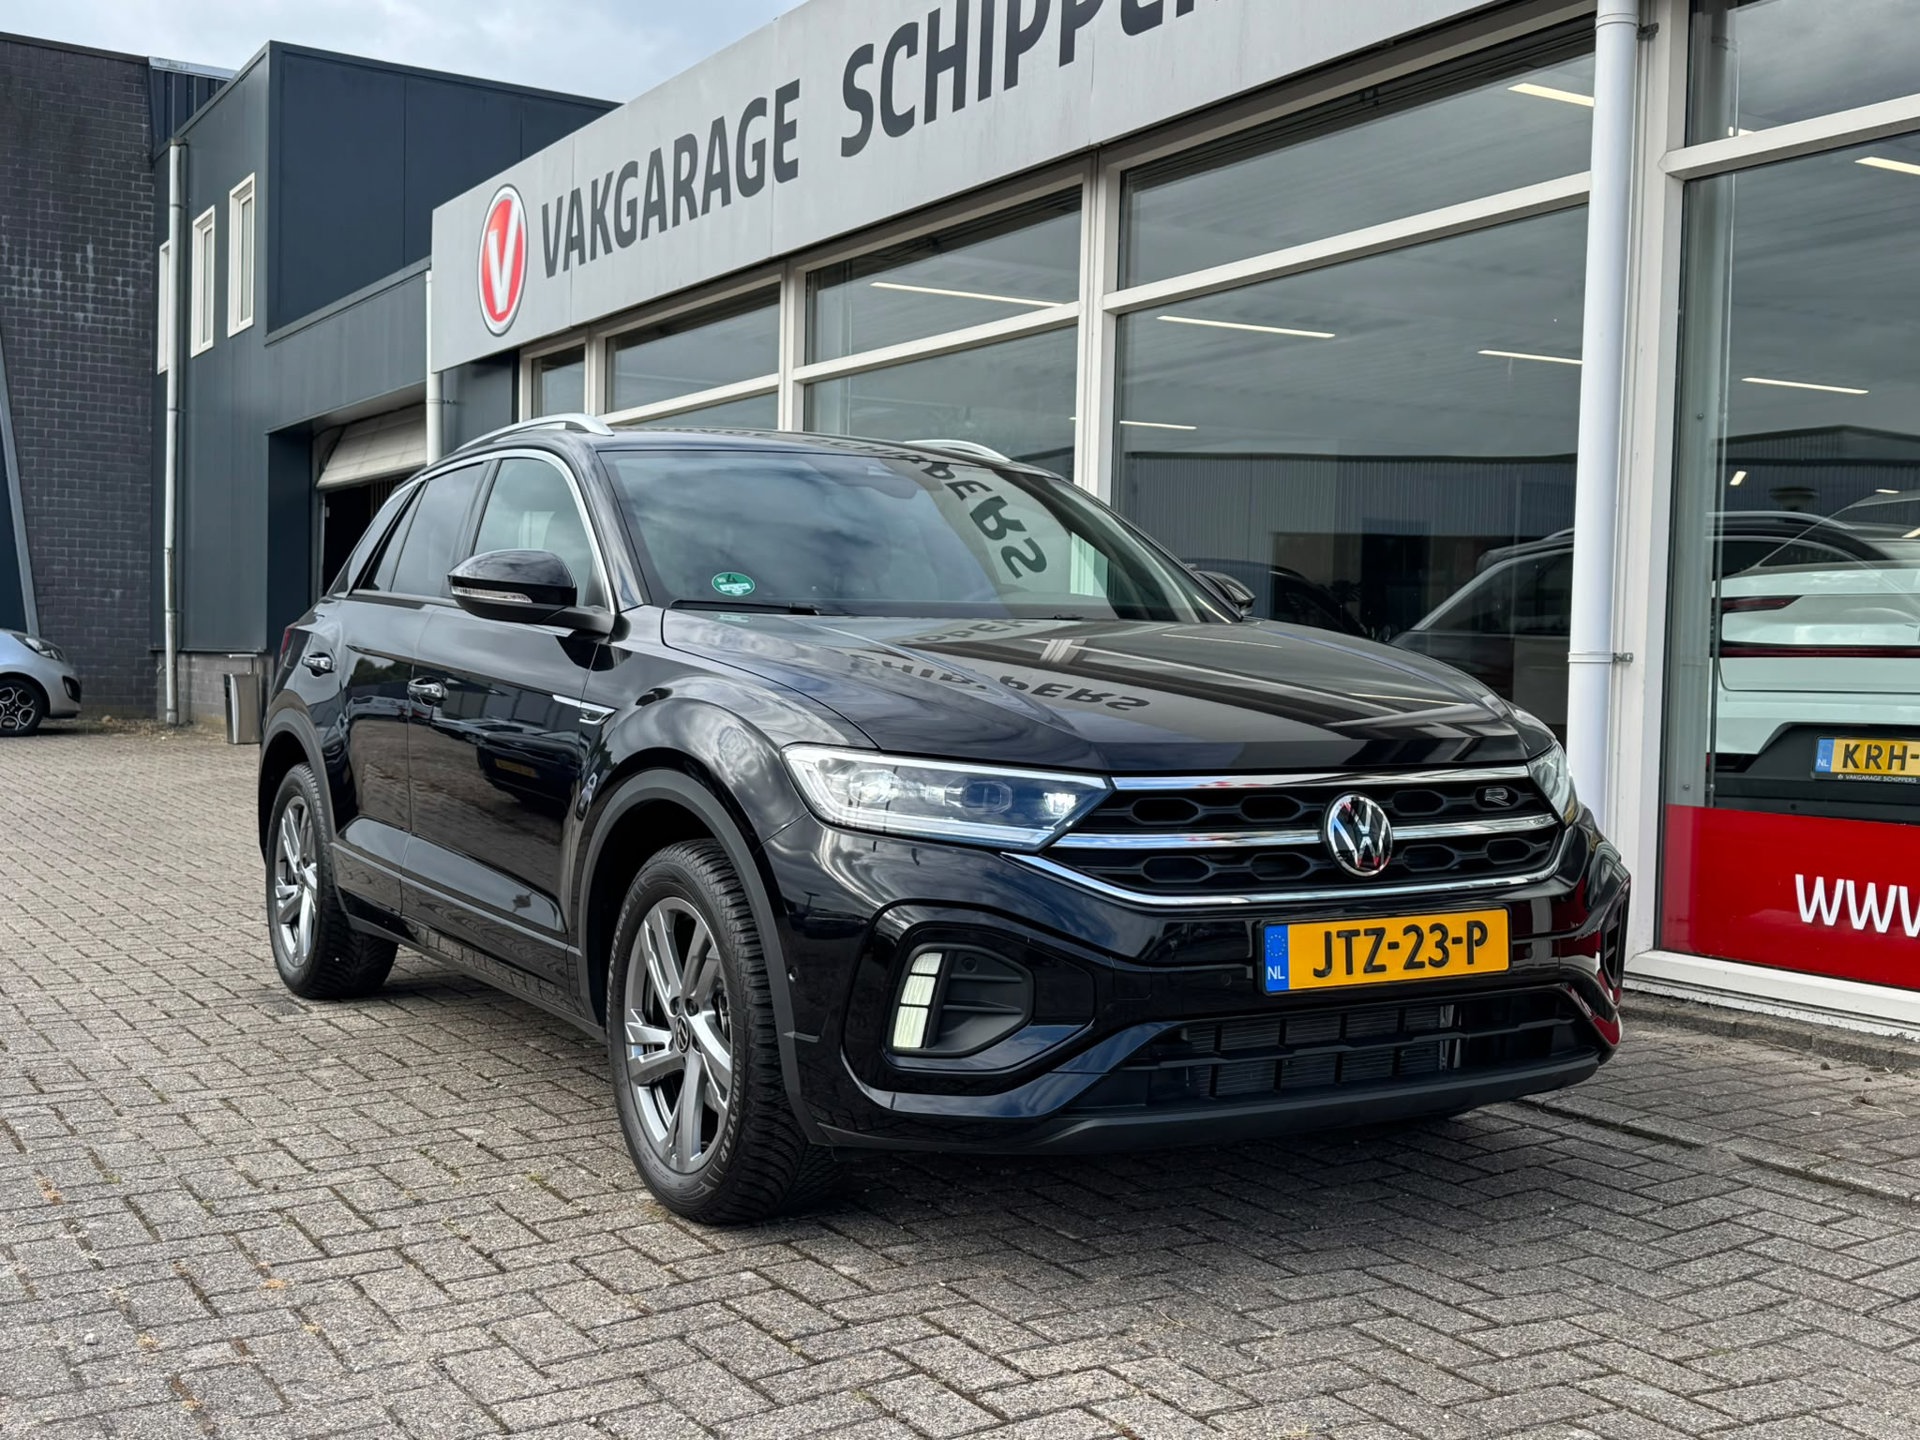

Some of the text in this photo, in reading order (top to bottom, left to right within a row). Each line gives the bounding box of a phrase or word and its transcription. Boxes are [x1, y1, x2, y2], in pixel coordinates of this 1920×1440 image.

[541, 0, 1195, 279] VAKGARAGE SCHIPP
[1817, 758, 1830, 768] NL
[1312, 919, 1489, 979] JTZ-23-P
[1266, 965, 1286, 981] NL
